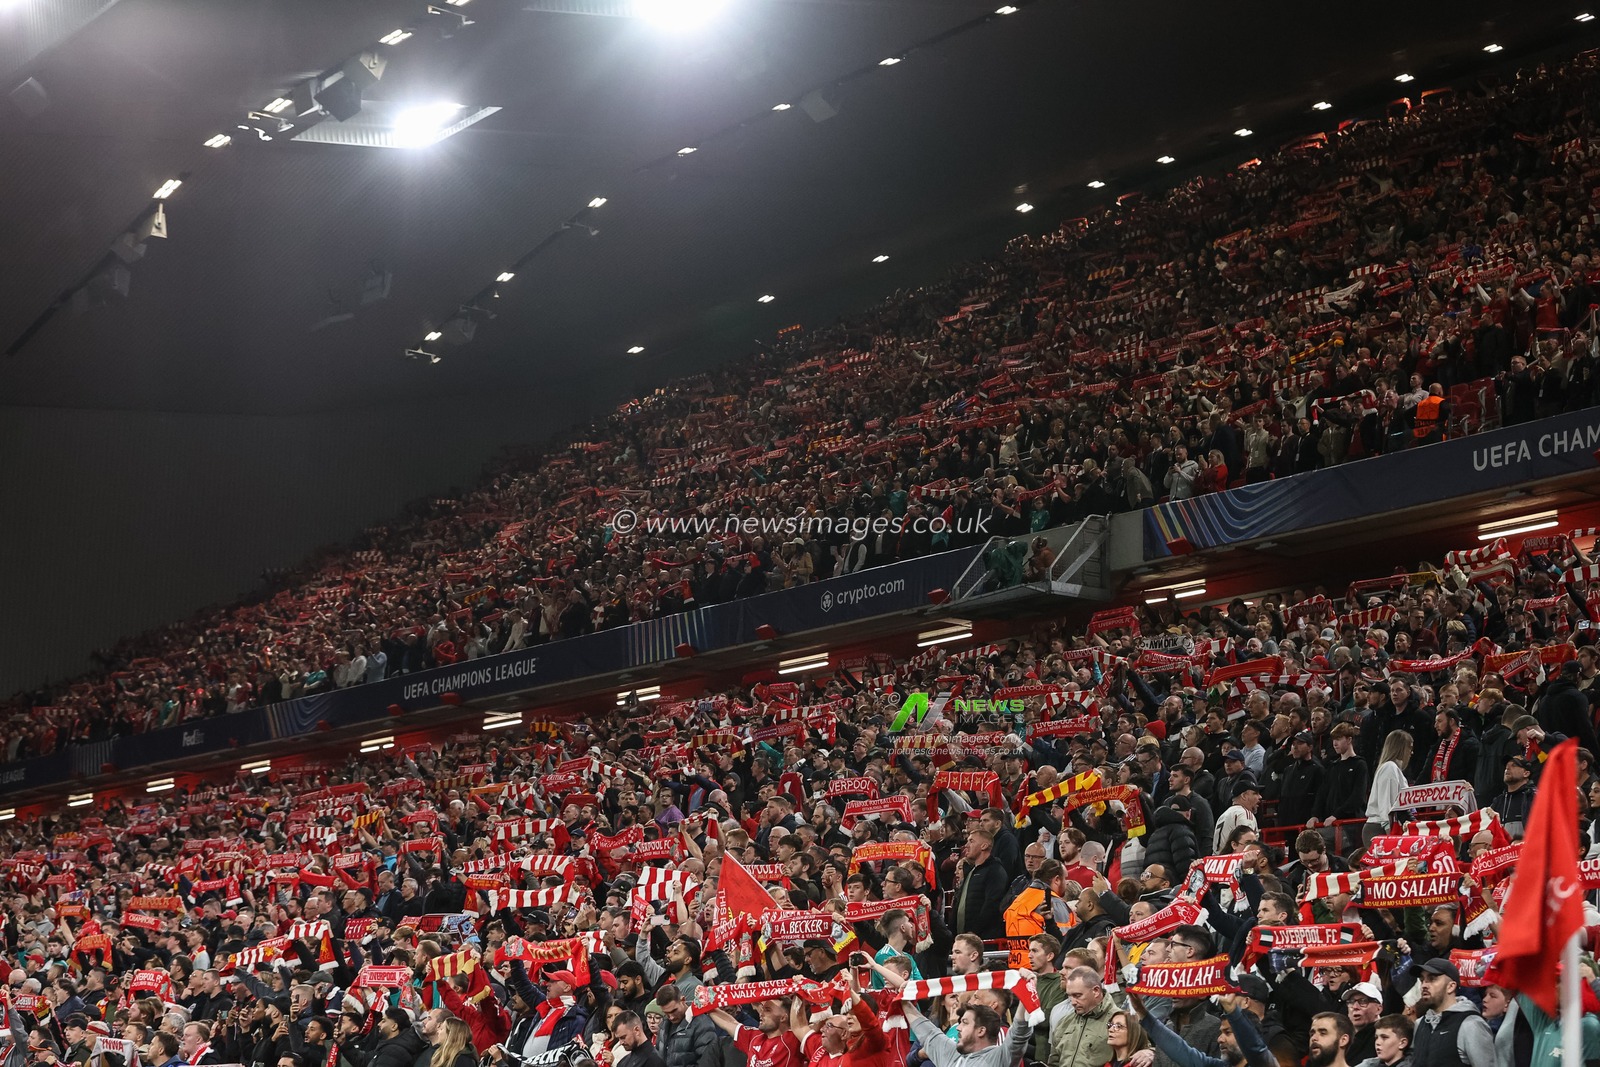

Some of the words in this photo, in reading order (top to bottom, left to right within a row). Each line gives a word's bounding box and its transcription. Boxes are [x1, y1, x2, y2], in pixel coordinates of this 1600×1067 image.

[1473, 440, 1531, 471] UEFA
[1538, 425, 1600, 458] CHAM
[837, 578, 905, 604] crypto.com
[404, 682, 429, 700] UEFA
[432, 668, 492, 694] CHAMPIONS
[495, 658, 536, 681] LEAGUE
[998, 684, 1045, 696] LIVERPOOL
[2, 768, 26, 783] LEAGUE
[829, 779, 870, 793] VERPOOL
[893, 796, 904, 804] CLUB
[1399, 786, 1451, 807] LIVERPOOL
[1452, 785, 1465, 801] FC
[664, 839, 672, 849] FC
[1433, 855, 1455, 873] 20
[1495, 850, 1519, 865] FOOTBALL
[1204, 859, 1227, 875] VAN
[1373, 881, 1396, 899] MO
[1400, 877, 1450, 898] SALAH
[718, 888, 727, 915] THIS
[1422, 896, 1446, 904] EGYPTIAN
[780, 919, 822, 934] A.BECKER
[1131, 914, 1157, 932] FOOTBALL
[1158, 907, 1173, 920] CLUB
[1274, 928, 1323, 945] LIVERPOOL
[1326, 928, 1338, 944] FC
[368, 971, 397, 981] LIVERPOOL
[1146, 969, 1168, 988] MO
[1170, 965, 1215, 988] SALAH
[758, 979, 788, 989] NEVER
[1187, 987, 1210, 995] EGYPTIAN
[730, 990, 757, 999] WALK
[759, 987, 786, 997] ALONE
[102, 1038, 124, 1052] YNWA
